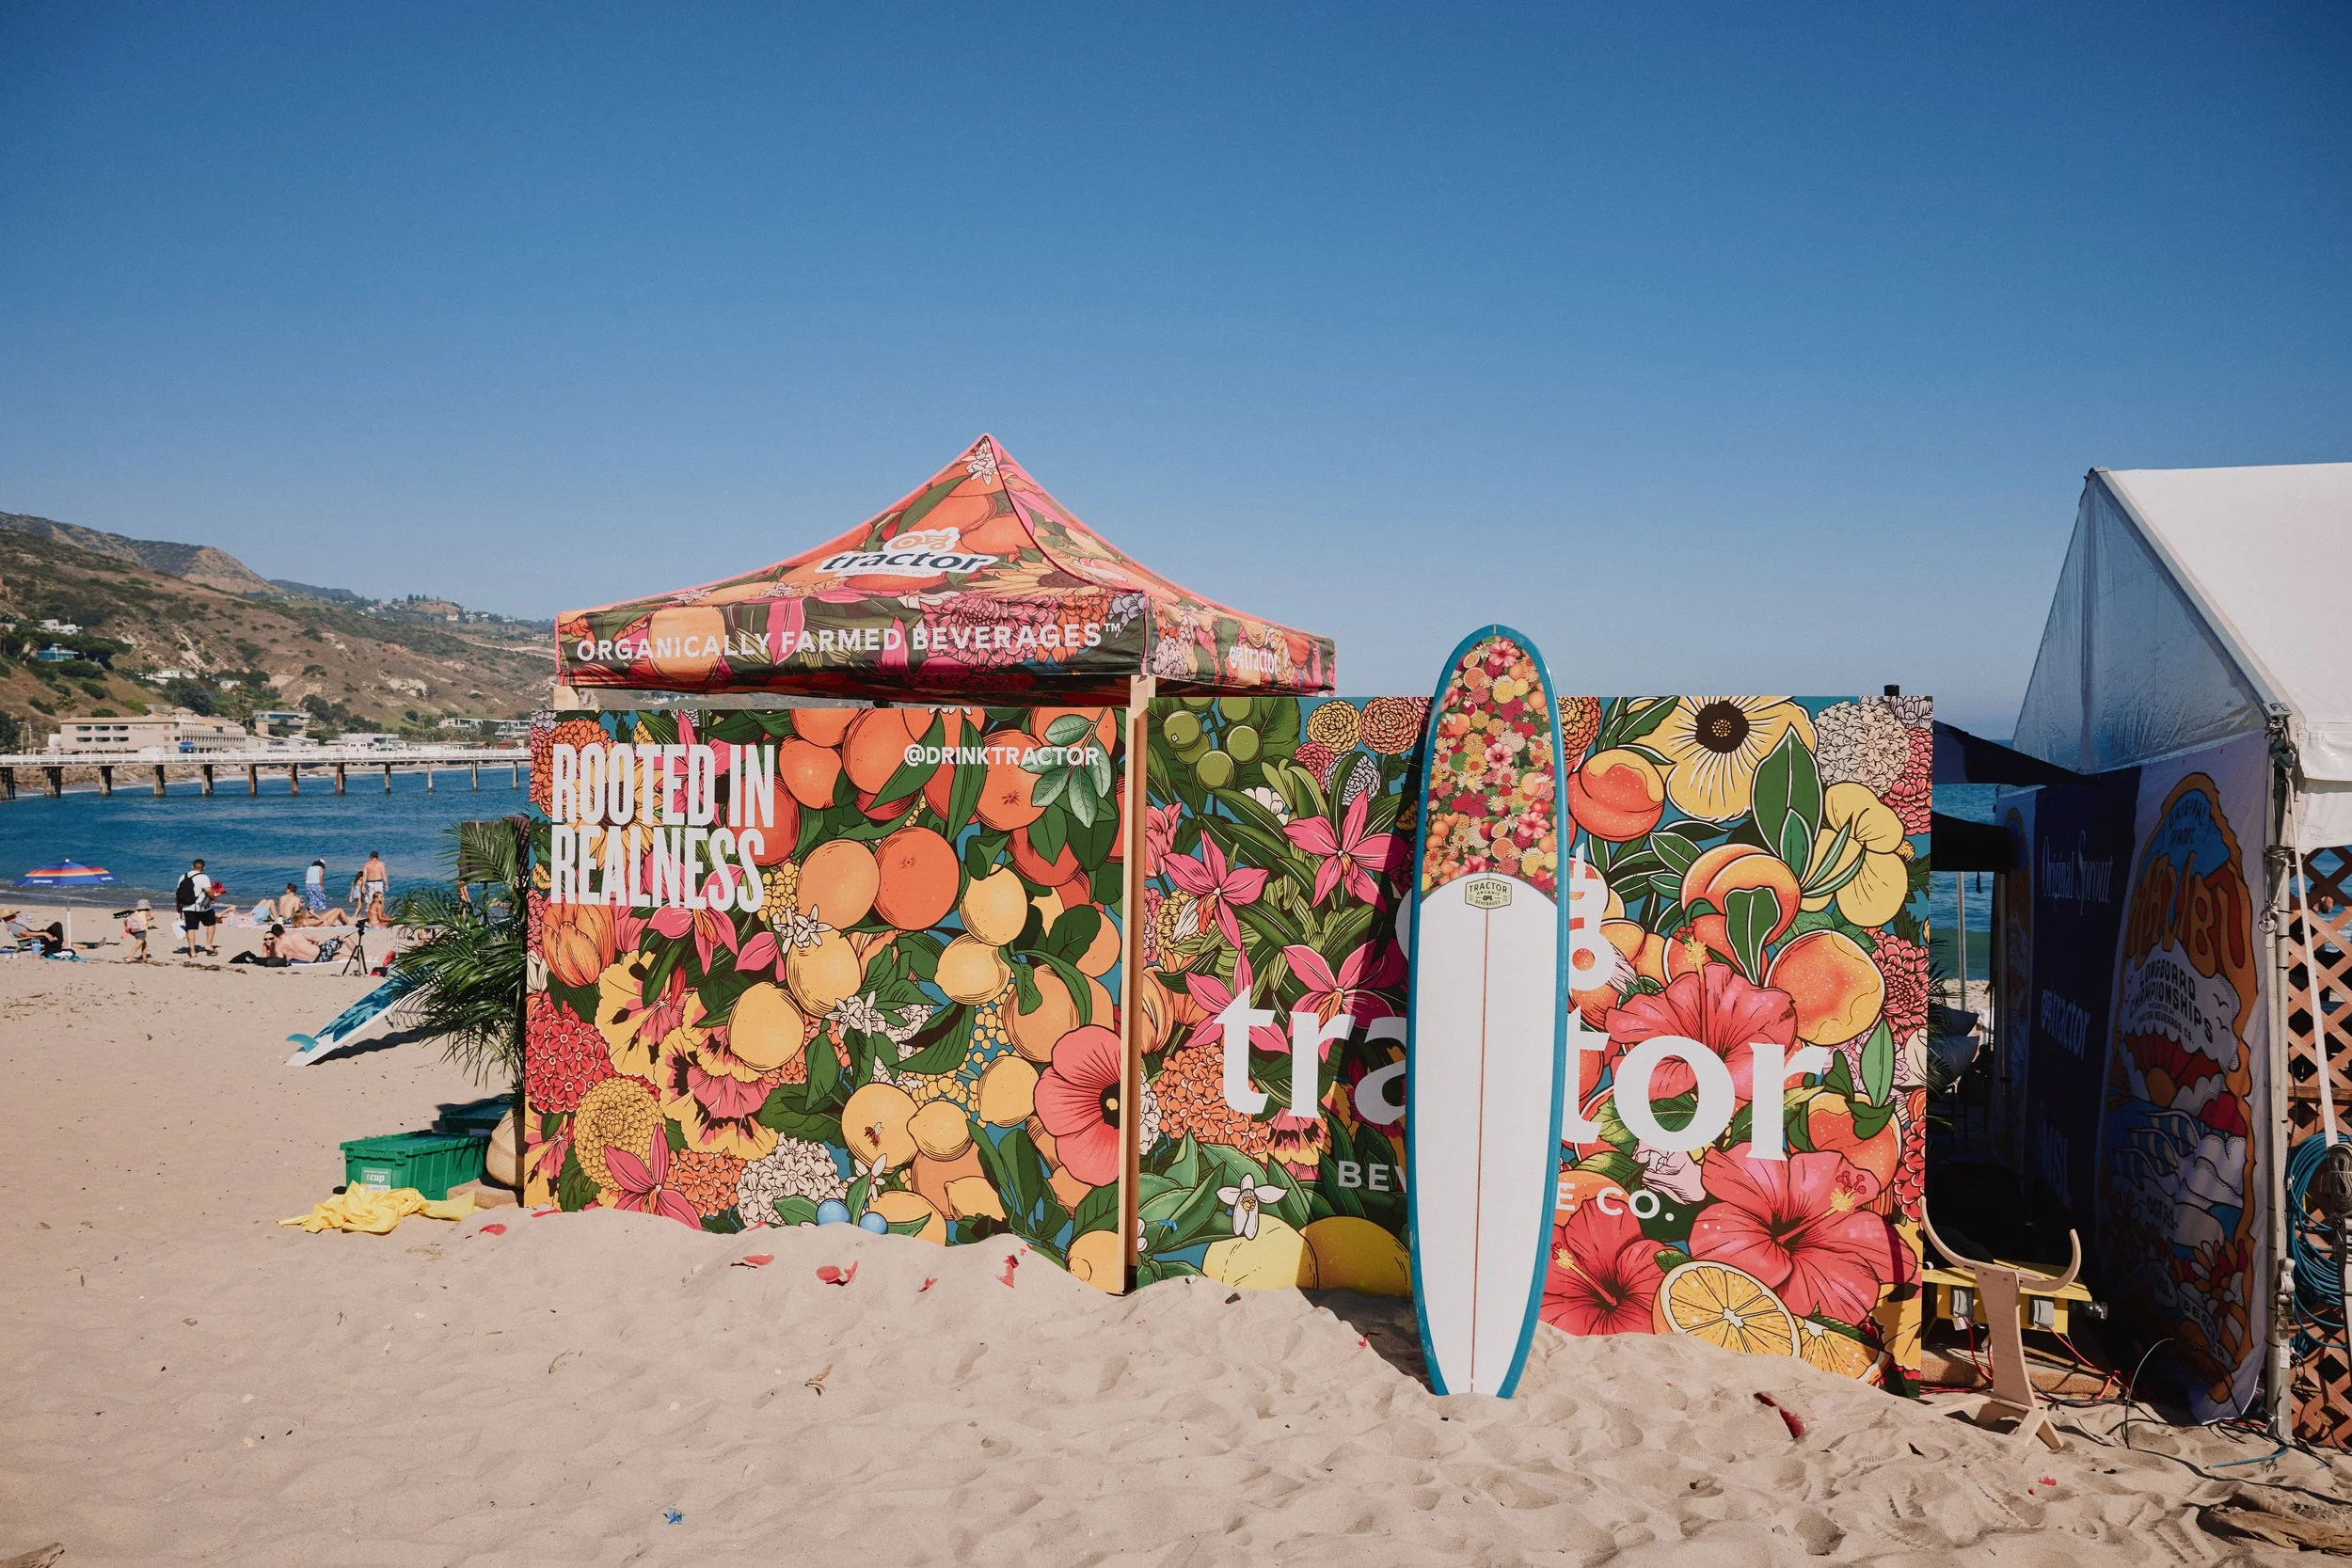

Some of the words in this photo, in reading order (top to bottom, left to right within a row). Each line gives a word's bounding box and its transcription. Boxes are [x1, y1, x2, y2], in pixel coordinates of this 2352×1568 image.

[823, 550, 989, 571] tractor
[577, 632, 771, 661] ORGANICALLY
[781, 627, 902, 654] FARMED
[904, 742, 1100, 767] @DRINKTRACTOR
[551, 742, 716, 827] ROOTED
[729, 744, 775, 828] IN
[550, 824, 765, 913] REALNESS
[1469, 881, 1508, 894] TRACTOR
[2042, 834, 2075, 913] Original
[2139, 958, 2196, 1001] LONGBOARD
[2129, 981, 2214, 1044] CHAMPIONSHIPS
[1213, 982, 1832, 1162] trator
[1596, 1184, 1675, 1223] CO.
